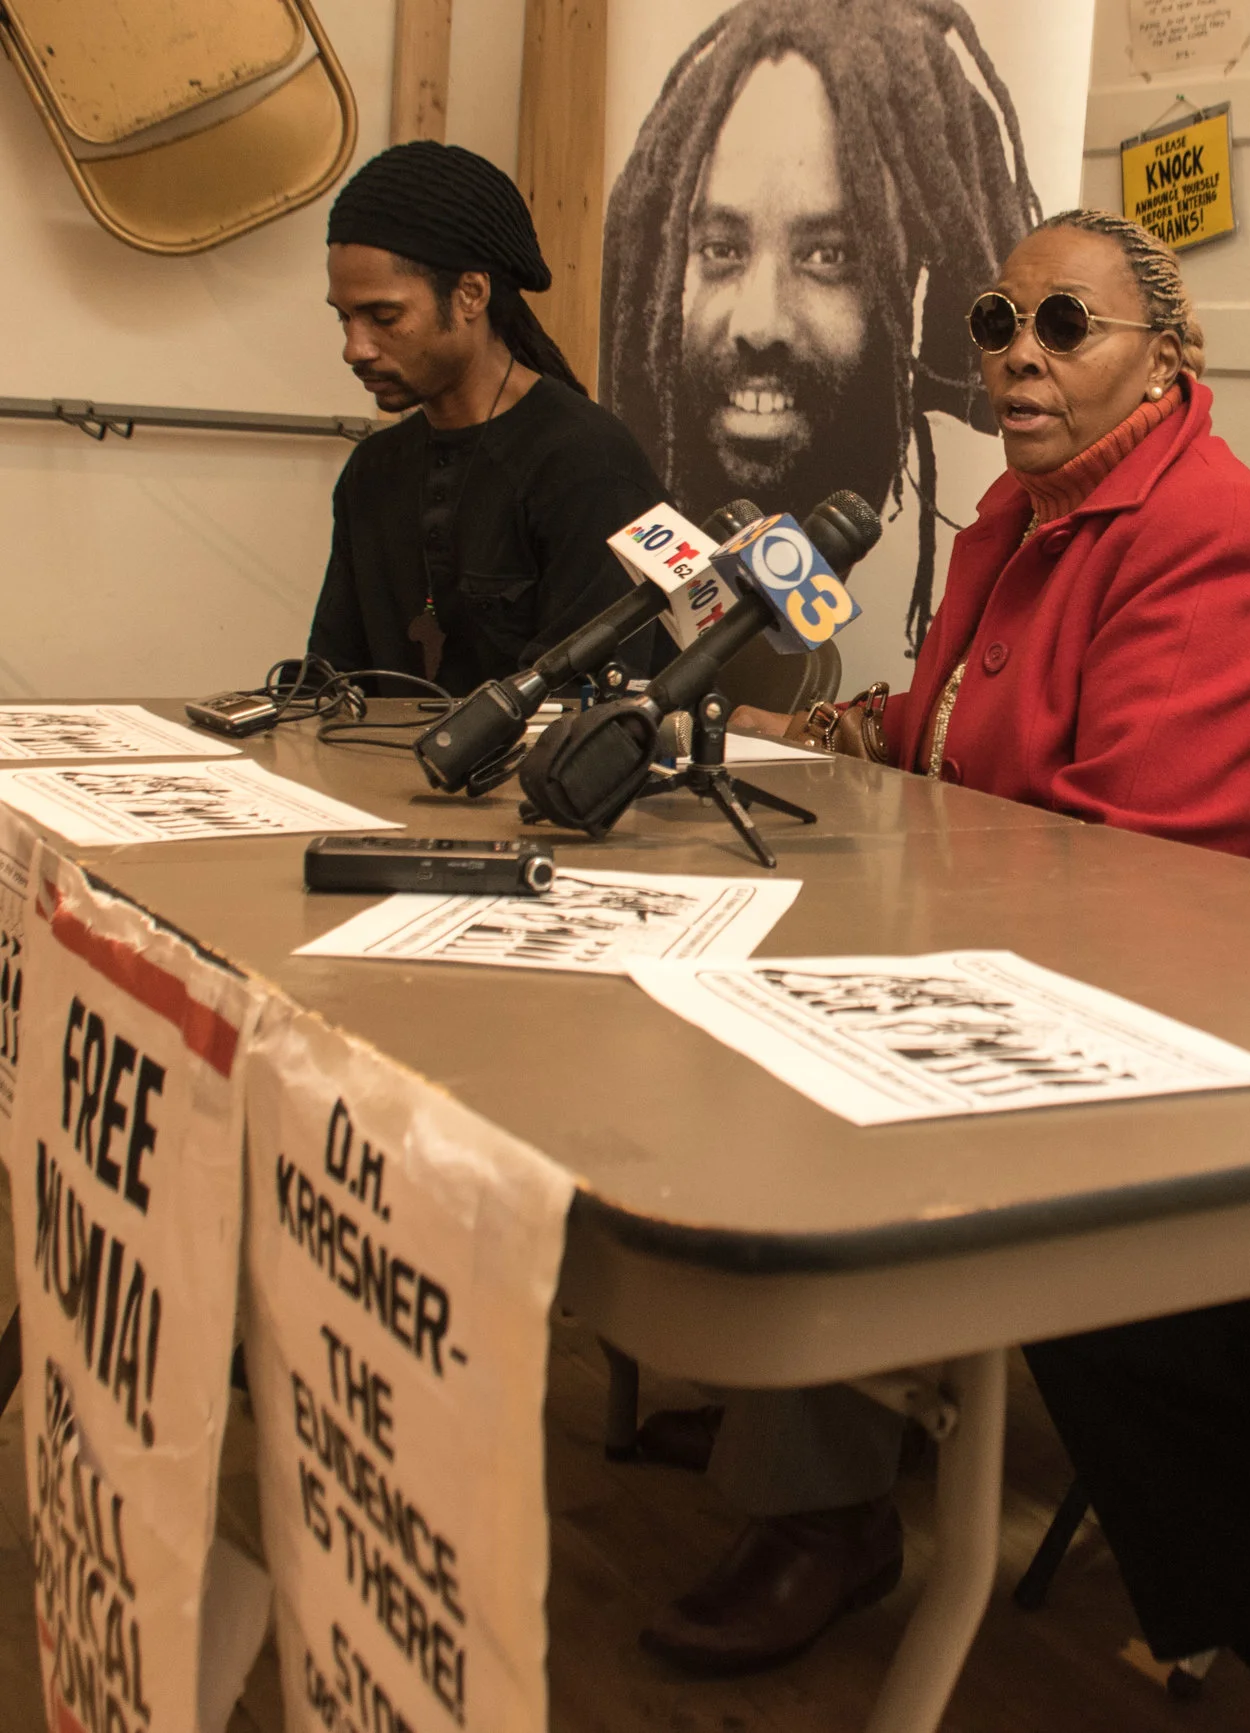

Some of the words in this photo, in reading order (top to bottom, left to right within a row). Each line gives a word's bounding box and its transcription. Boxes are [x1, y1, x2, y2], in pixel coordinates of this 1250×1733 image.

[1146, 145, 1204, 194] KNOCK
[1155, 136, 1186, 157] PLEASE
[1135, 189, 1178, 216] ANNOUNCE
[1182, 172, 1219, 197] YOURSELF
[1142, 205, 1172, 227] BEFORE
[1177, 189, 1217, 213] ENTERING
[1148, 208, 1204, 243] THANKS!
[643, 524, 674, 551] 10
[673, 562, 694, 579] 62
[786, 574, 852, 642] 3
[62, 995, 166, 1216] FREE
[276, 1153, 469, 1379] KRASNER-
[320, 1324, 395, 1465] THE
[298, 1457, 332, 1552] IS
[336, 1504, 466, 1729] THERE!
